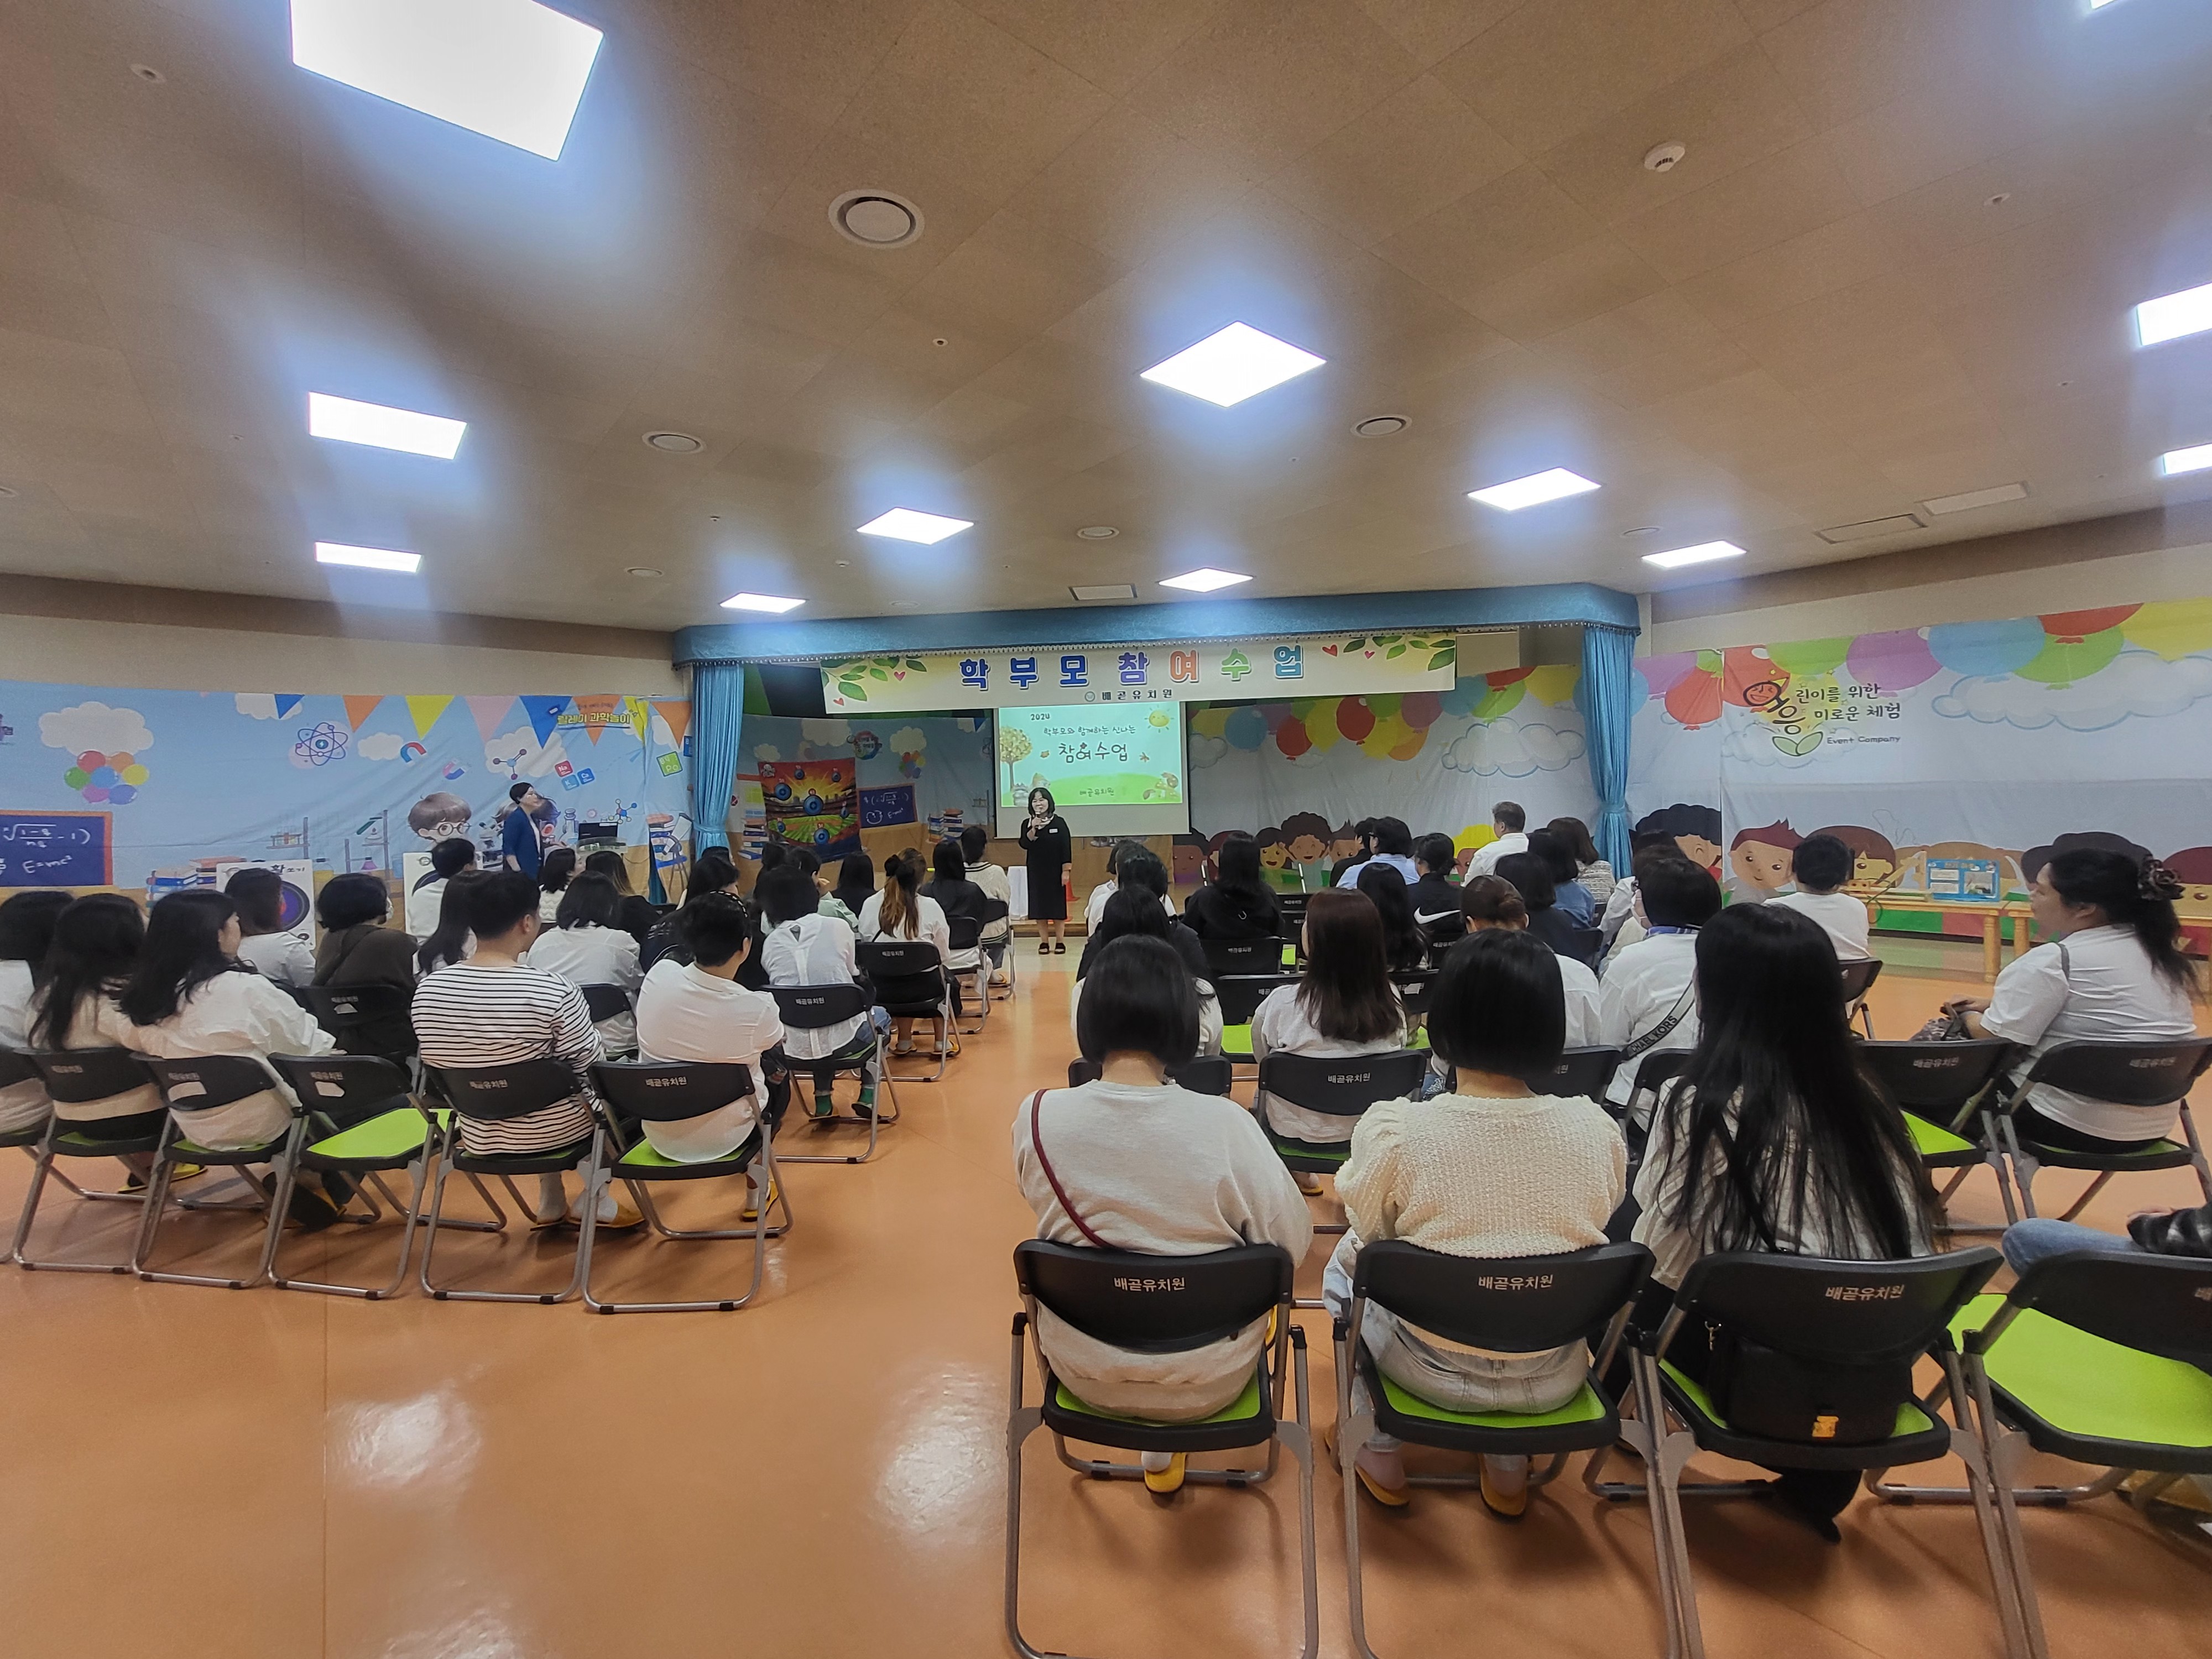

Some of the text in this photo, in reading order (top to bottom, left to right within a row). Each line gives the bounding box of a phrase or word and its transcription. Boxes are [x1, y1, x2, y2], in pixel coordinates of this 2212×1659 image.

[1102, 689, 1172, 701] 배곧유치원
[1848, 684, 1881, 699] 위한
[1866, 702, 1901, 719] 체험
[589, 712, 631, 724] 과학놀이
[1044, 725, 1136, 737] 학부모와 함께하는 신나는
[1653, 1015, 1678, 1039] KORS
[1913, 1057, 1959, 1068] 배곧유치원
[645, 1076, 687, 1087] 배곧유치원
[1328, 1072, 1370, 1083] 배곧유치원
[1113, 1277, 1186, 1292] 배곧유치원
[1478, 1274, 1553, 1290] 배곧유치원
[1825, 1285, 1905, 1301] 배곧유치원
